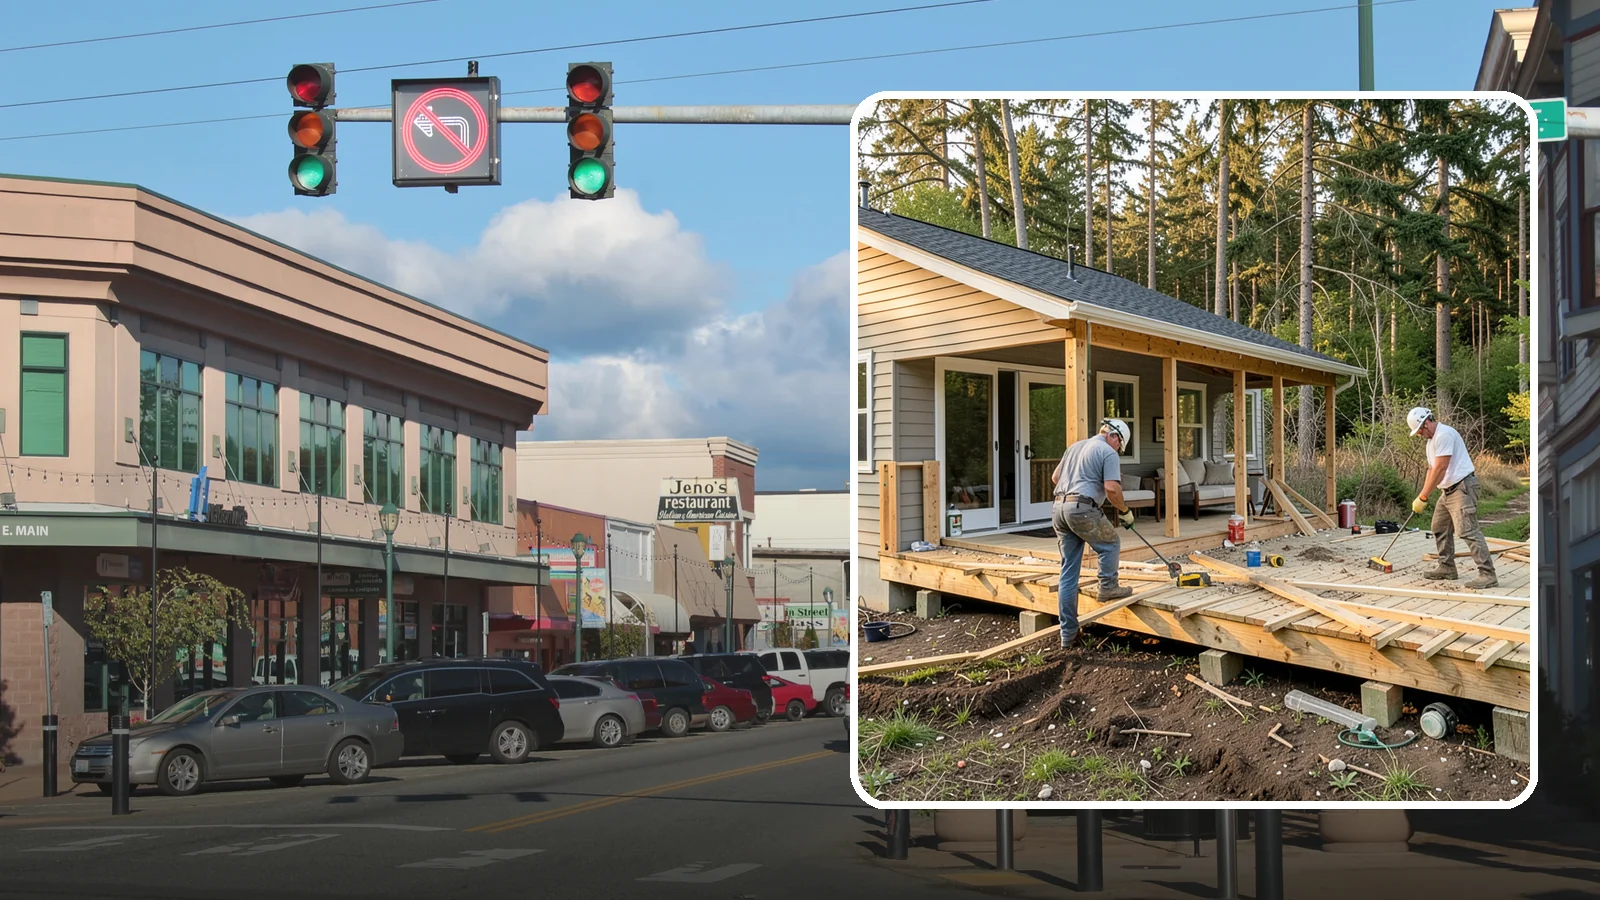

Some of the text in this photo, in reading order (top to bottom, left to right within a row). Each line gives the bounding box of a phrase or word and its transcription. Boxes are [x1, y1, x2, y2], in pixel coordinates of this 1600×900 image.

[670, 480, 727, 495] Jeno's
[665, 496, 731, 509] restaurant
[658, 510, 681, 519] Italian
[686, 510, 715, 519] American
[715, 510, 737, 519] Cuisine
[2, 525, 49, 536] E. MAIN
[785, 607, 795, 616] in
[797, 608, 828, 617] Street
[790, 619, 824, 627] lass
